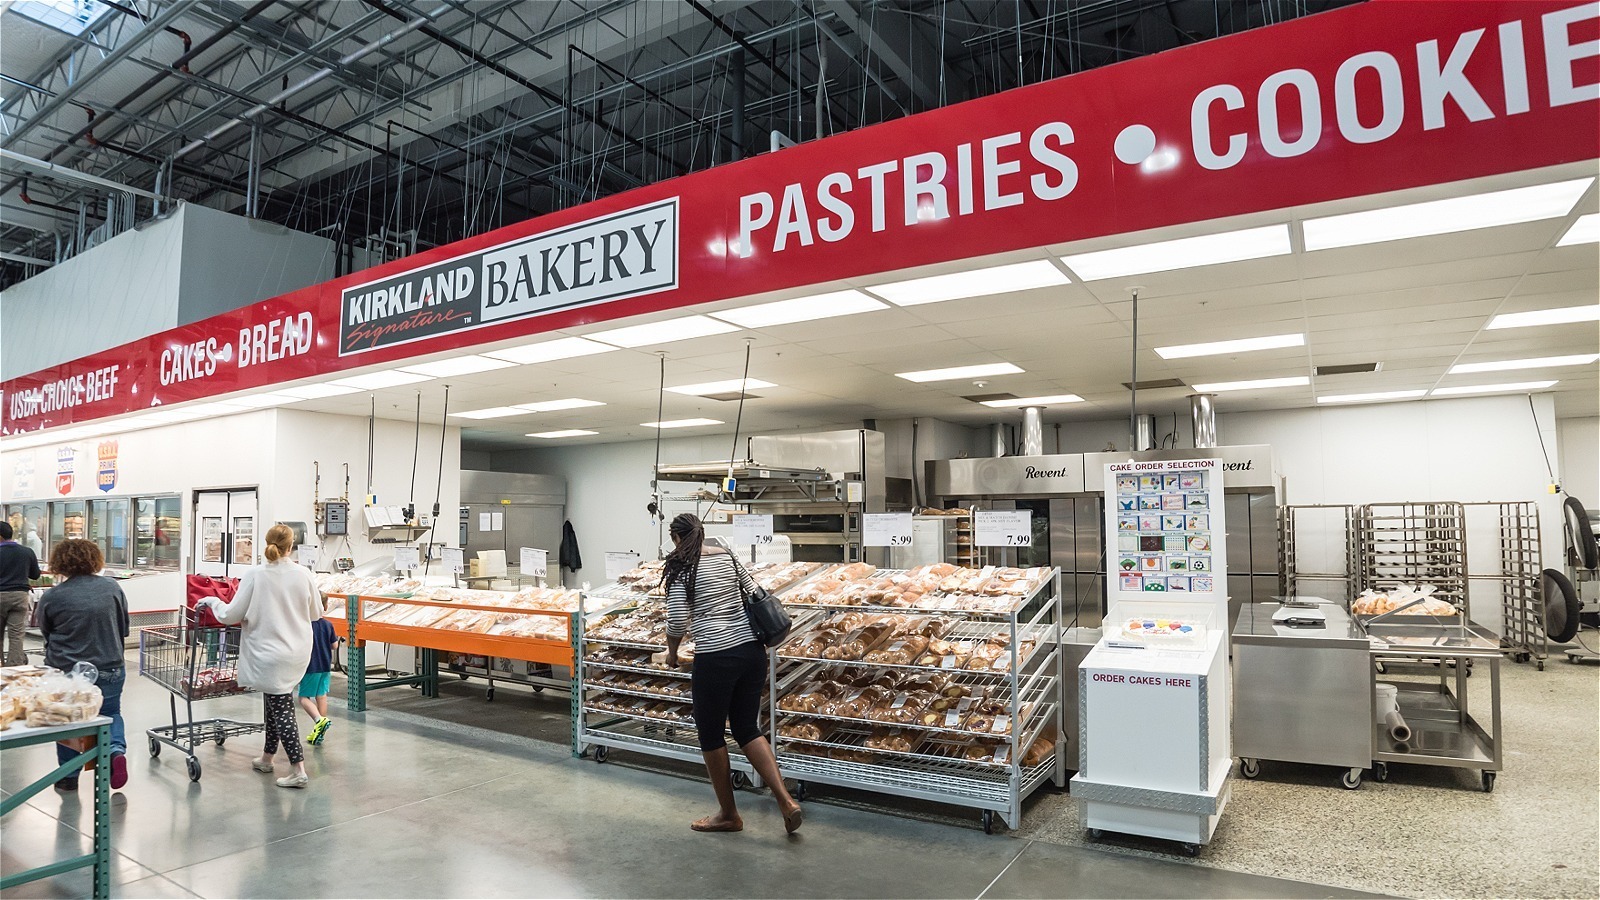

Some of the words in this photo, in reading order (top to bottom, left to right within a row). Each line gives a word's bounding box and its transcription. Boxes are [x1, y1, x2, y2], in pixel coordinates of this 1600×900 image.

[739, 121, 1080, 259] PASTRIES
[484, 218, 668, 308] BAKERY
[348, 265, 476, 326] KIRKLAND
[346, 309, 472, 350] Signature
[238, 311, 313, 368] BREAD
[160, 337, 217, 386] CAKES
[10, 387, 39, 421] USDA
[40, 374, 84, 414] CHOICE
[85, 364, 120, 403] BEEF
[1025, 465, 1067, 479] Revent
[1110, 464, 1132, 472] CAKE
[1135, 463, 1164, 471] ORDER
[1167, 460, 1215, 469] SELECTION
[1222, 459, 1252, 471] vent
[755, 535, 773, 544] 7.99
[890, 535, 912, 545] 5.99
[1006, 534, 1030, 546] 7.99
[534, 568, 547, 576] 6.99
[1092, 673, 1125, 683] ORDER
[1129, 675, 1162, 686] CAKES
[1165, 678, 1192, 688] HERE
